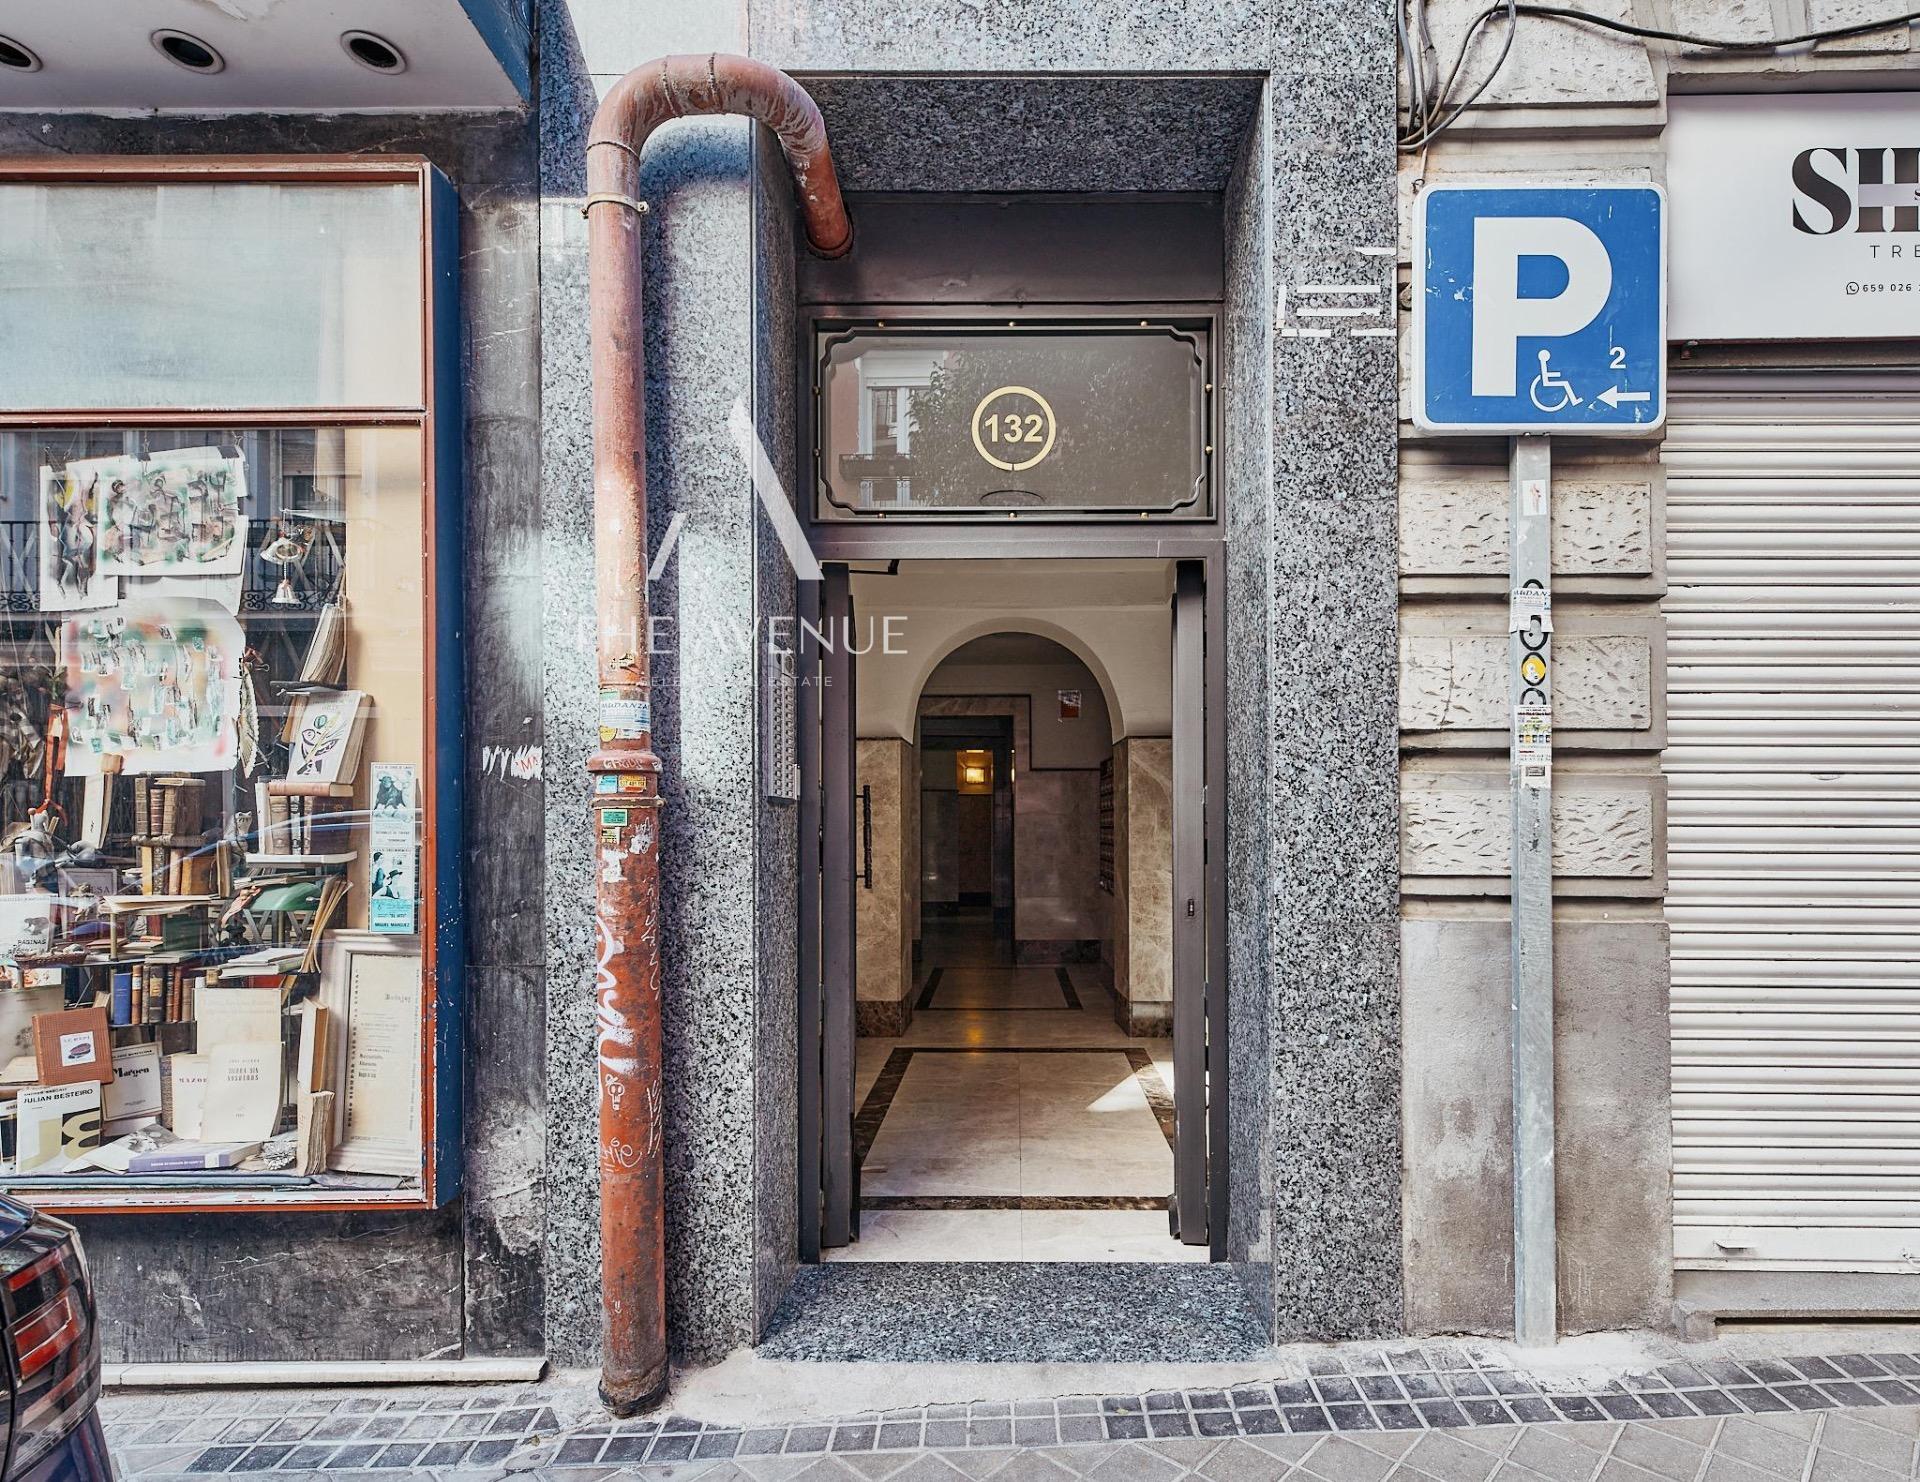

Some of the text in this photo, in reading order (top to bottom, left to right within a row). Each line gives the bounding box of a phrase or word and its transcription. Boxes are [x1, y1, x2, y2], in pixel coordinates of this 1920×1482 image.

[1862, 284, 1885, 293] 659
[1890, 284, 1912, 293] 026
[1472, 216, 1613, 397] P
[1608, 346, 1627, 369] 2
[984, 413, 1043, 444] 132
[24, 1088, 93, 1104] JULIAN BESTEIRO
